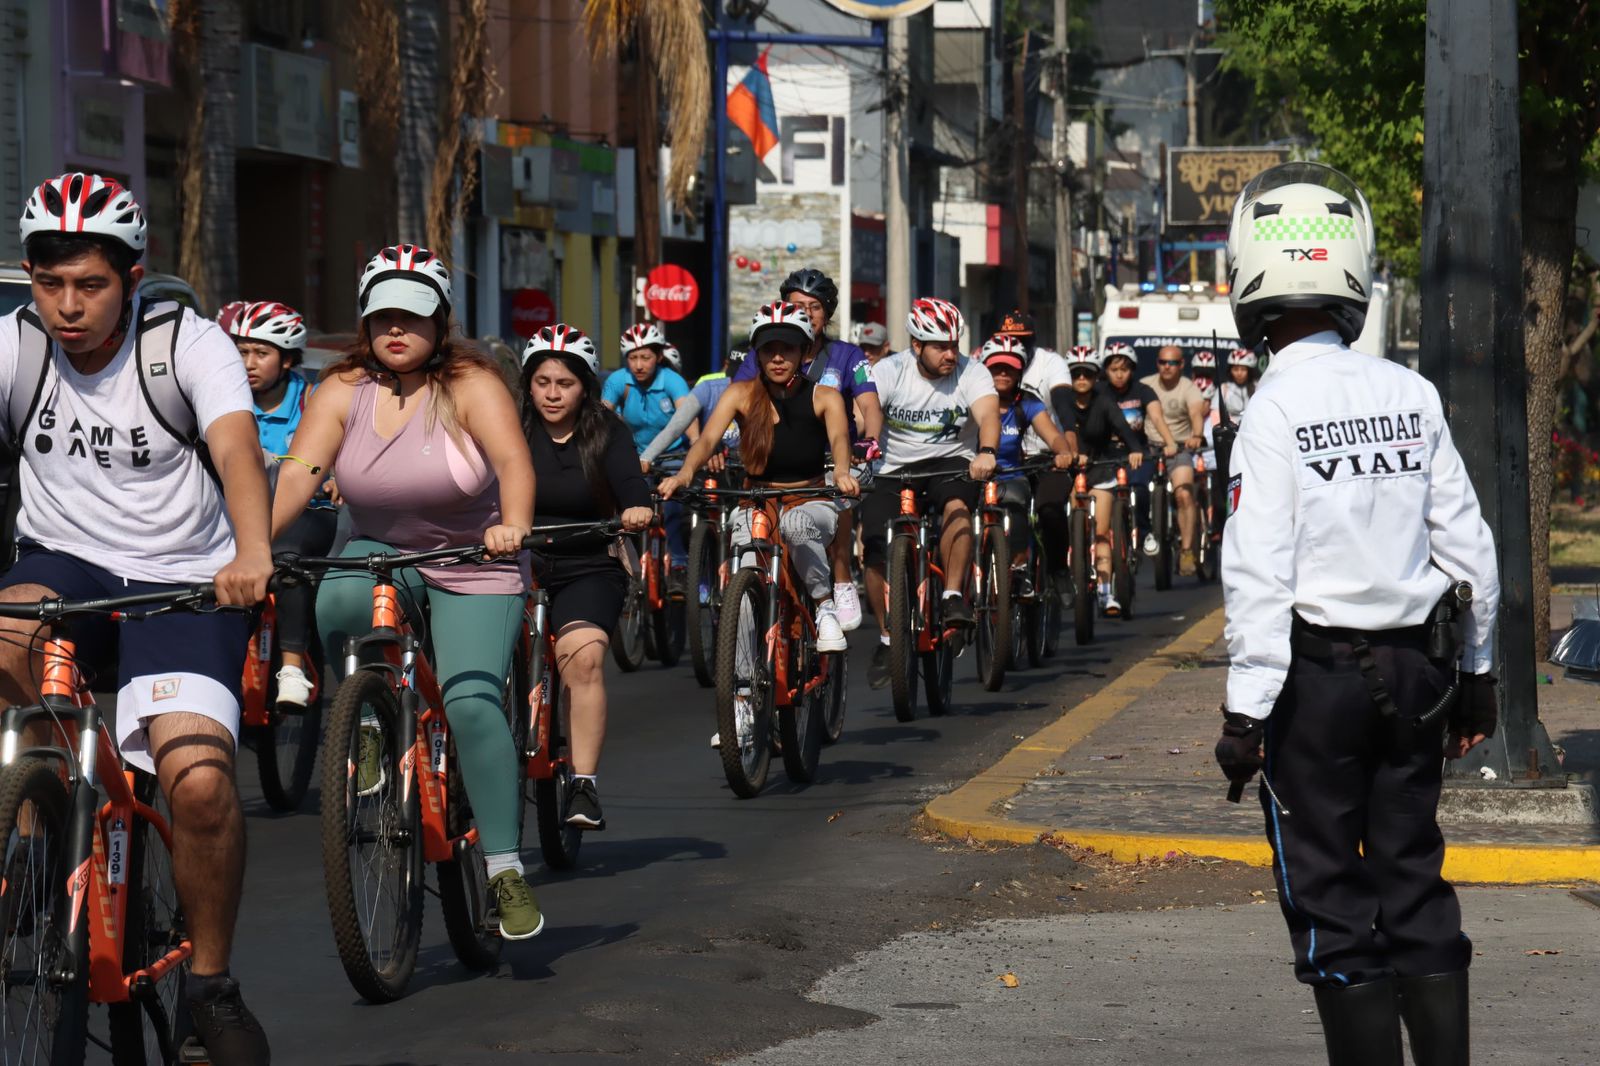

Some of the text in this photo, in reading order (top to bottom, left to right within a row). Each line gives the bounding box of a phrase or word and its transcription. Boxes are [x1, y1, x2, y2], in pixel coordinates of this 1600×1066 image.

[756, 114, 845, 186] FI
[1282, 248, 1329, 261] TX2
[38, 409, 149, 448] GAME
[886, 404, 931, 422] CARRERA
[1296, 412, 1422, 453] SEGURIDAD
[1305, 449, 1422, 482] VIAL
[434, 741, 442, 766] 018
[111, 840, 121, 875] 139
